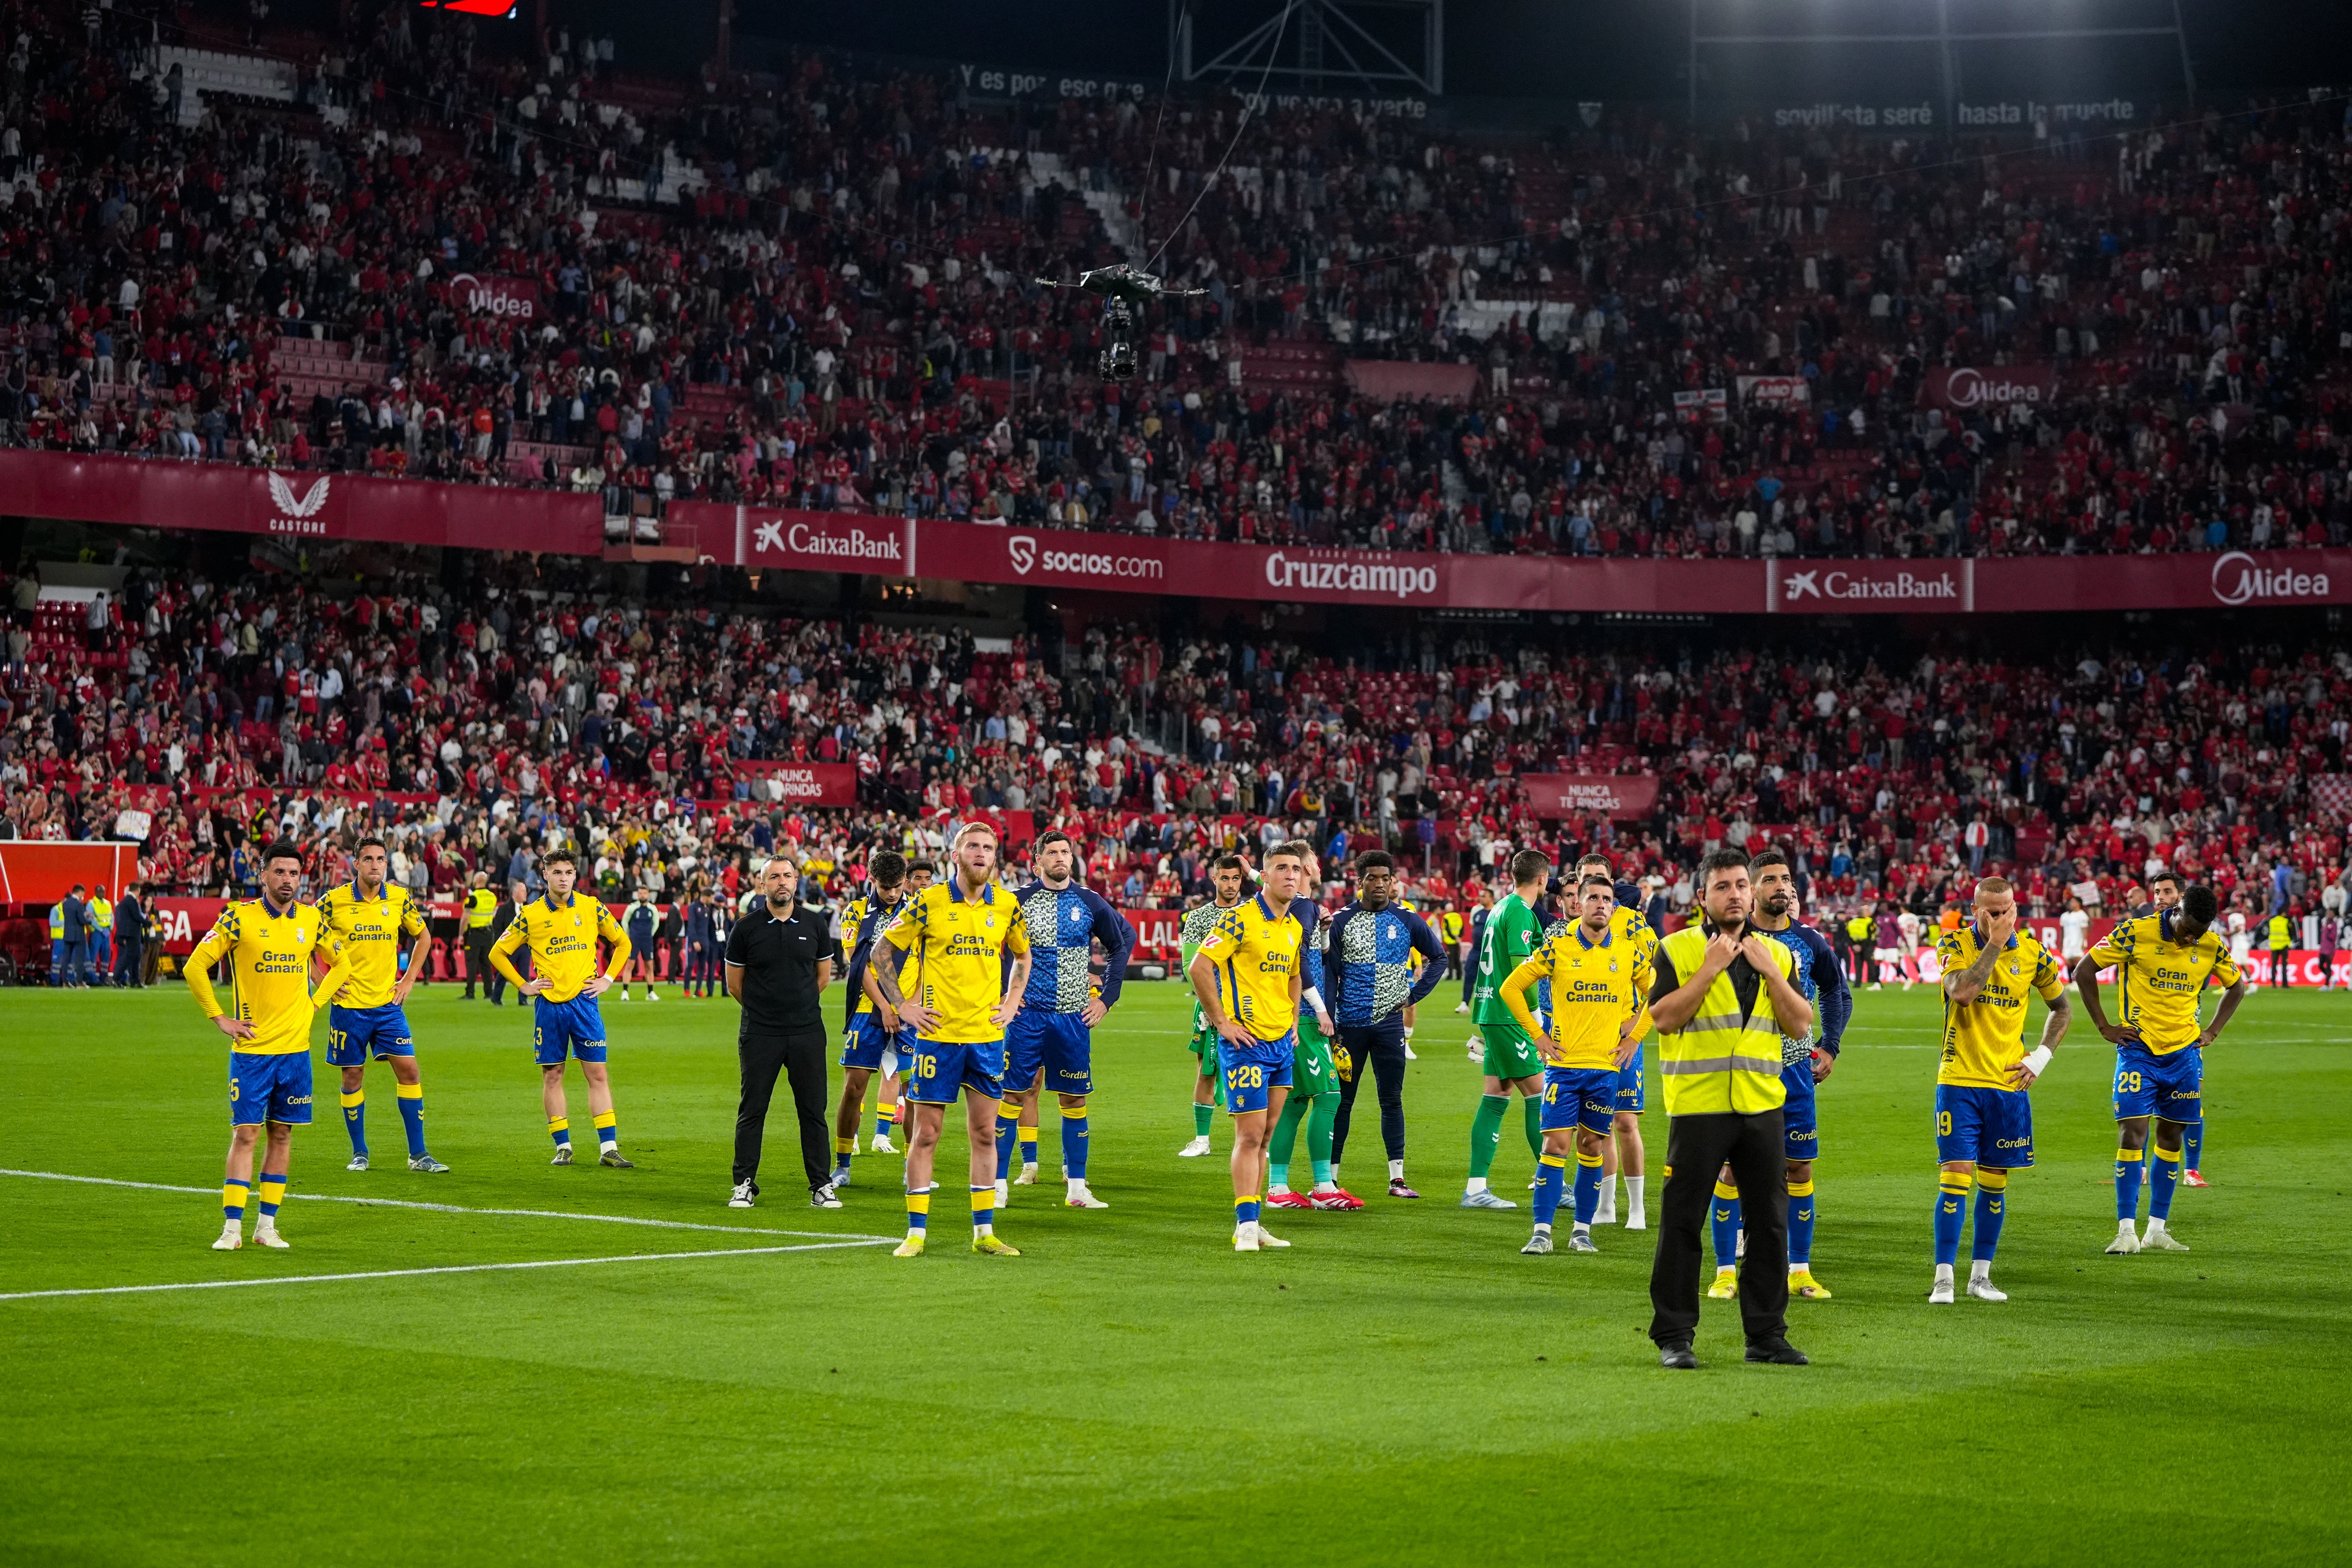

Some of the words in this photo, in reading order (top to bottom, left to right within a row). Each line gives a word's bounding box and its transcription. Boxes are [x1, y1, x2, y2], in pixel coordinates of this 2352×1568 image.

[960, 64, 975, 88] Y
[980, 71, 1005, 90] es
[1883, 100, 1932, 125] seré
[1958, 101, 2021, 124] hasta
[462, 285, 533, 318] Midea
[1958, 376, 2039, 407] Midea
[269, 518, 326, 534] CASTORE
[788, 523, 902, 560] CaixaBank
[1265, 550, 1437, 598] Cruzcampo
[1823, 571, 1957, 598] CaixaBank
[2224, 564, 2330, 605] Midea
[778, 768, 813, 783] NUNCA
[1569, 784, 1610, 797] NUNCA
[1559, 796, 1574, 809] TE
[1577, 796, 1621, 810] RINDAS
[159, 909, 192, 942] GA
[354, 923, 382, 932] Gran
[348, 932, 392, 941] Canaria
[550, 935, 576, 946] Gran
[953, 933, 985, 945] Gran
[262, 950, 296, 962] Gran
[546, 942, 587, 956] Canaria
[946, 945, 995, 957] Canaria
[255, 962, 303, 973] Canaria
[2157, 967, 2188, 981] Gran
[1574, 980, 1607, 991] Gran
[1982, 983, 2009, 996] ran
[2149, 977, 2195, 993] Canaria
[1566, 991, 1618, 1003] Canaria
[1976, 994, 2020, 1008] anaria
[332, 1030, 347, 1050] 17
[396, 1037, 412, 1045] Cord
[536, 1027, 542, 1045] 3
[845, 1030, 859, 1050] 21
[1324, 1043, 1333, 1063] 1
[917, 1054, 937, 1079] 16
[1060, 1069, 1089, 1079] Cordial
[1238, 1066, 1262, 1088] 28
[2118, 1071, 2141, 1093] 29
[1542, 1082, 1559, 1105] 14
[1616, 1088, 1637, 1097] rdial
[2171, 1090, 2201, 1099] Cordial
[287, 1095, 312, 1105] Cordia
[1585, 1101, 1615, 1115] Cordial
[1936, 1110, 1952, 1137] 19
[1790, 1129, 1817, 1141] Cordi
[1996, 1135, 2030, 1148] Cordial
